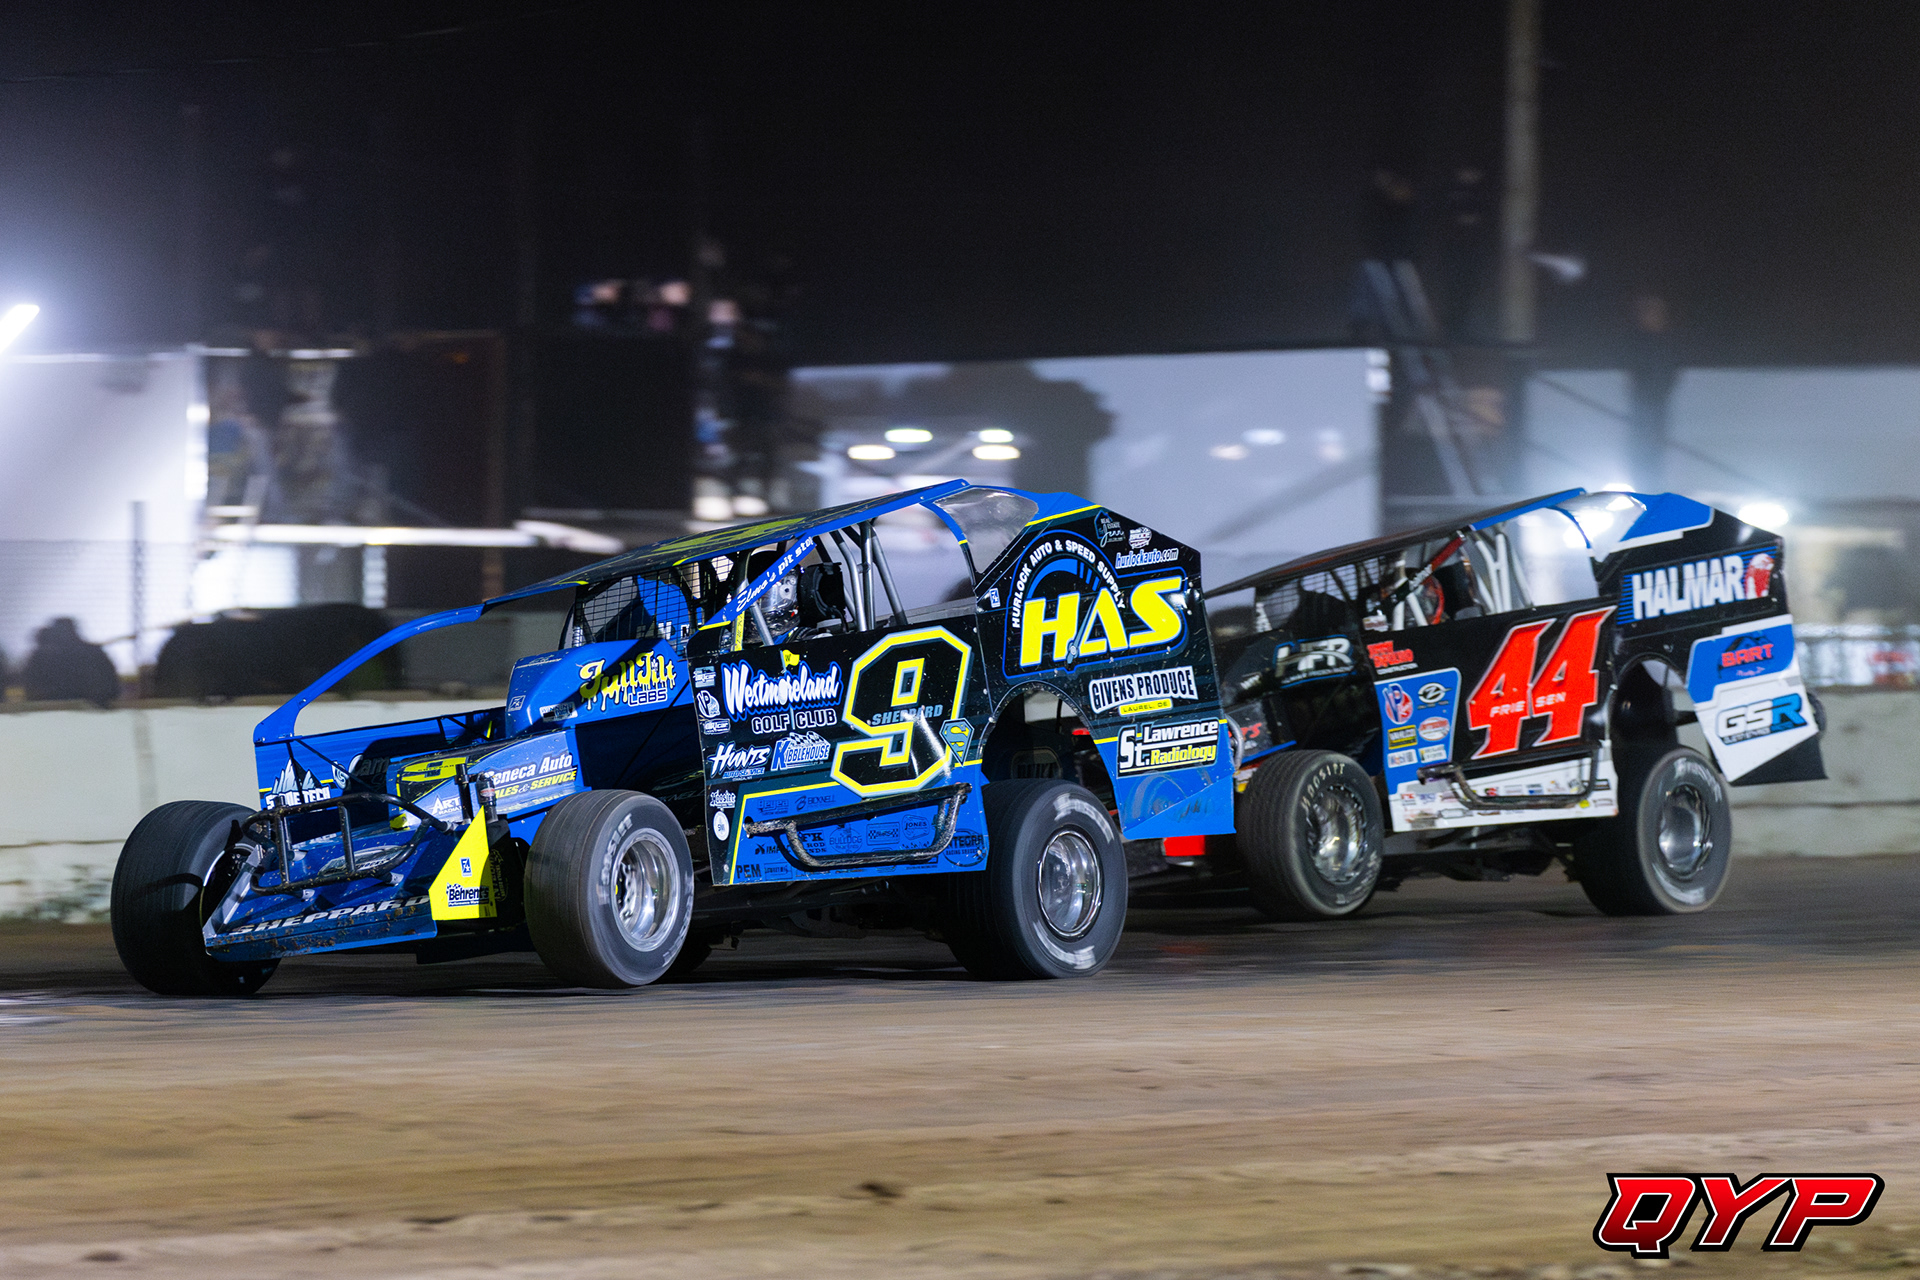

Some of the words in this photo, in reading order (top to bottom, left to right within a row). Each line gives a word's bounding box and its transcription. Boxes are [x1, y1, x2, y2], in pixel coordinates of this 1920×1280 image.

[778, 554, 794, 575] pit
[1115, 547, 1179, 569] hurlockauto.com
[1011, 563, 1033, 629] HURLOCK
[1028, 540, 1053, 568] AUTO
[1054, 539, 1063, 551] &
[1065, 539, 1096, 564] SPEED
[1096, 560, 1126, 609] SUPPLY
[1631, 555, 1745, 620] HALMAR
[1019, 575, 1183, 667] HAS
[1722, 643, 1774, 667] BART
[723, 663, 840, 715] Westmoreland
[1091, 677, 1135, 710] GIVENS
[1137, 669, 1195, 700] PRODUCE
[1466, 605, 1618, 760] 44
[752, 713, 790, 734] GOLF
[794, 708, 837, 728] CLUB
[830, 624, 973, 798] 9
[1717, 693, 1808, 739] GSR
[1143, 721, 1218, 743] Lawrence
[539, 753, 573, 774] Auto
[1151, 744, 1217, 765] Radiology
[530, 771, 577, 790] SERVICE
[302, 786, 331, 804] TECH
[736, 863, 762, 879] PEM
[230, 896, 430, 935] SHEPPARD
